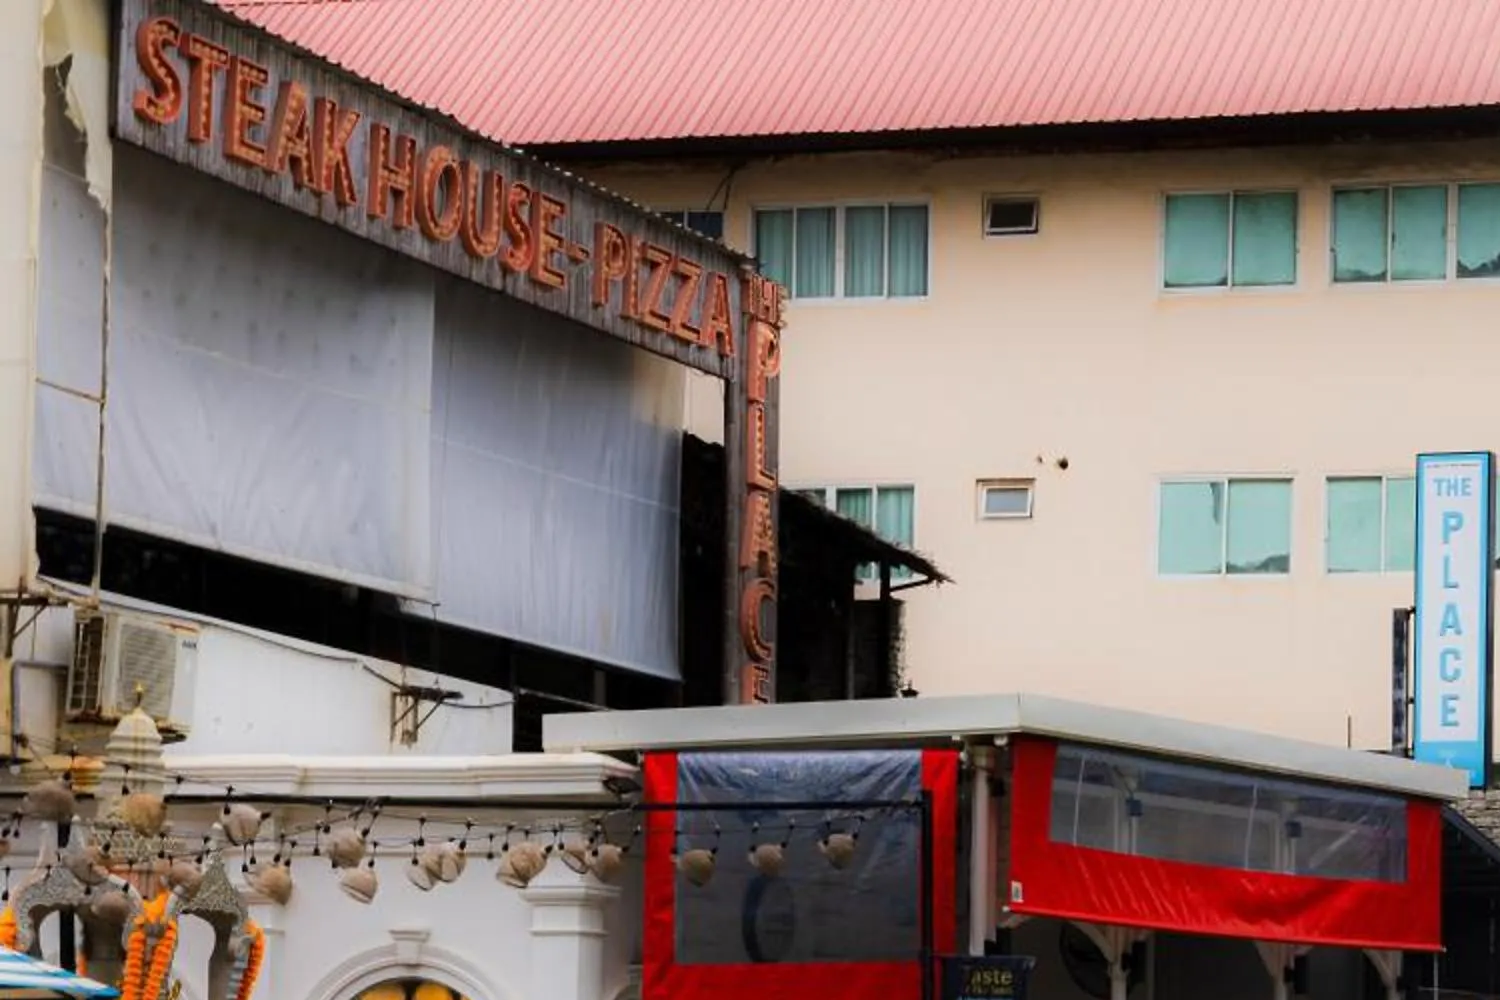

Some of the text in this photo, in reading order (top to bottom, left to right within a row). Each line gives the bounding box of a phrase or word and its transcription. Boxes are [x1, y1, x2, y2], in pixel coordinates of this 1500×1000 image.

[133, 17, 361, 206] STEAK
[592, 220, 736, 359] PIZZA
[1432, 476, 1472, 497] THE
[1439, 510, 1465, 729] PLACE
